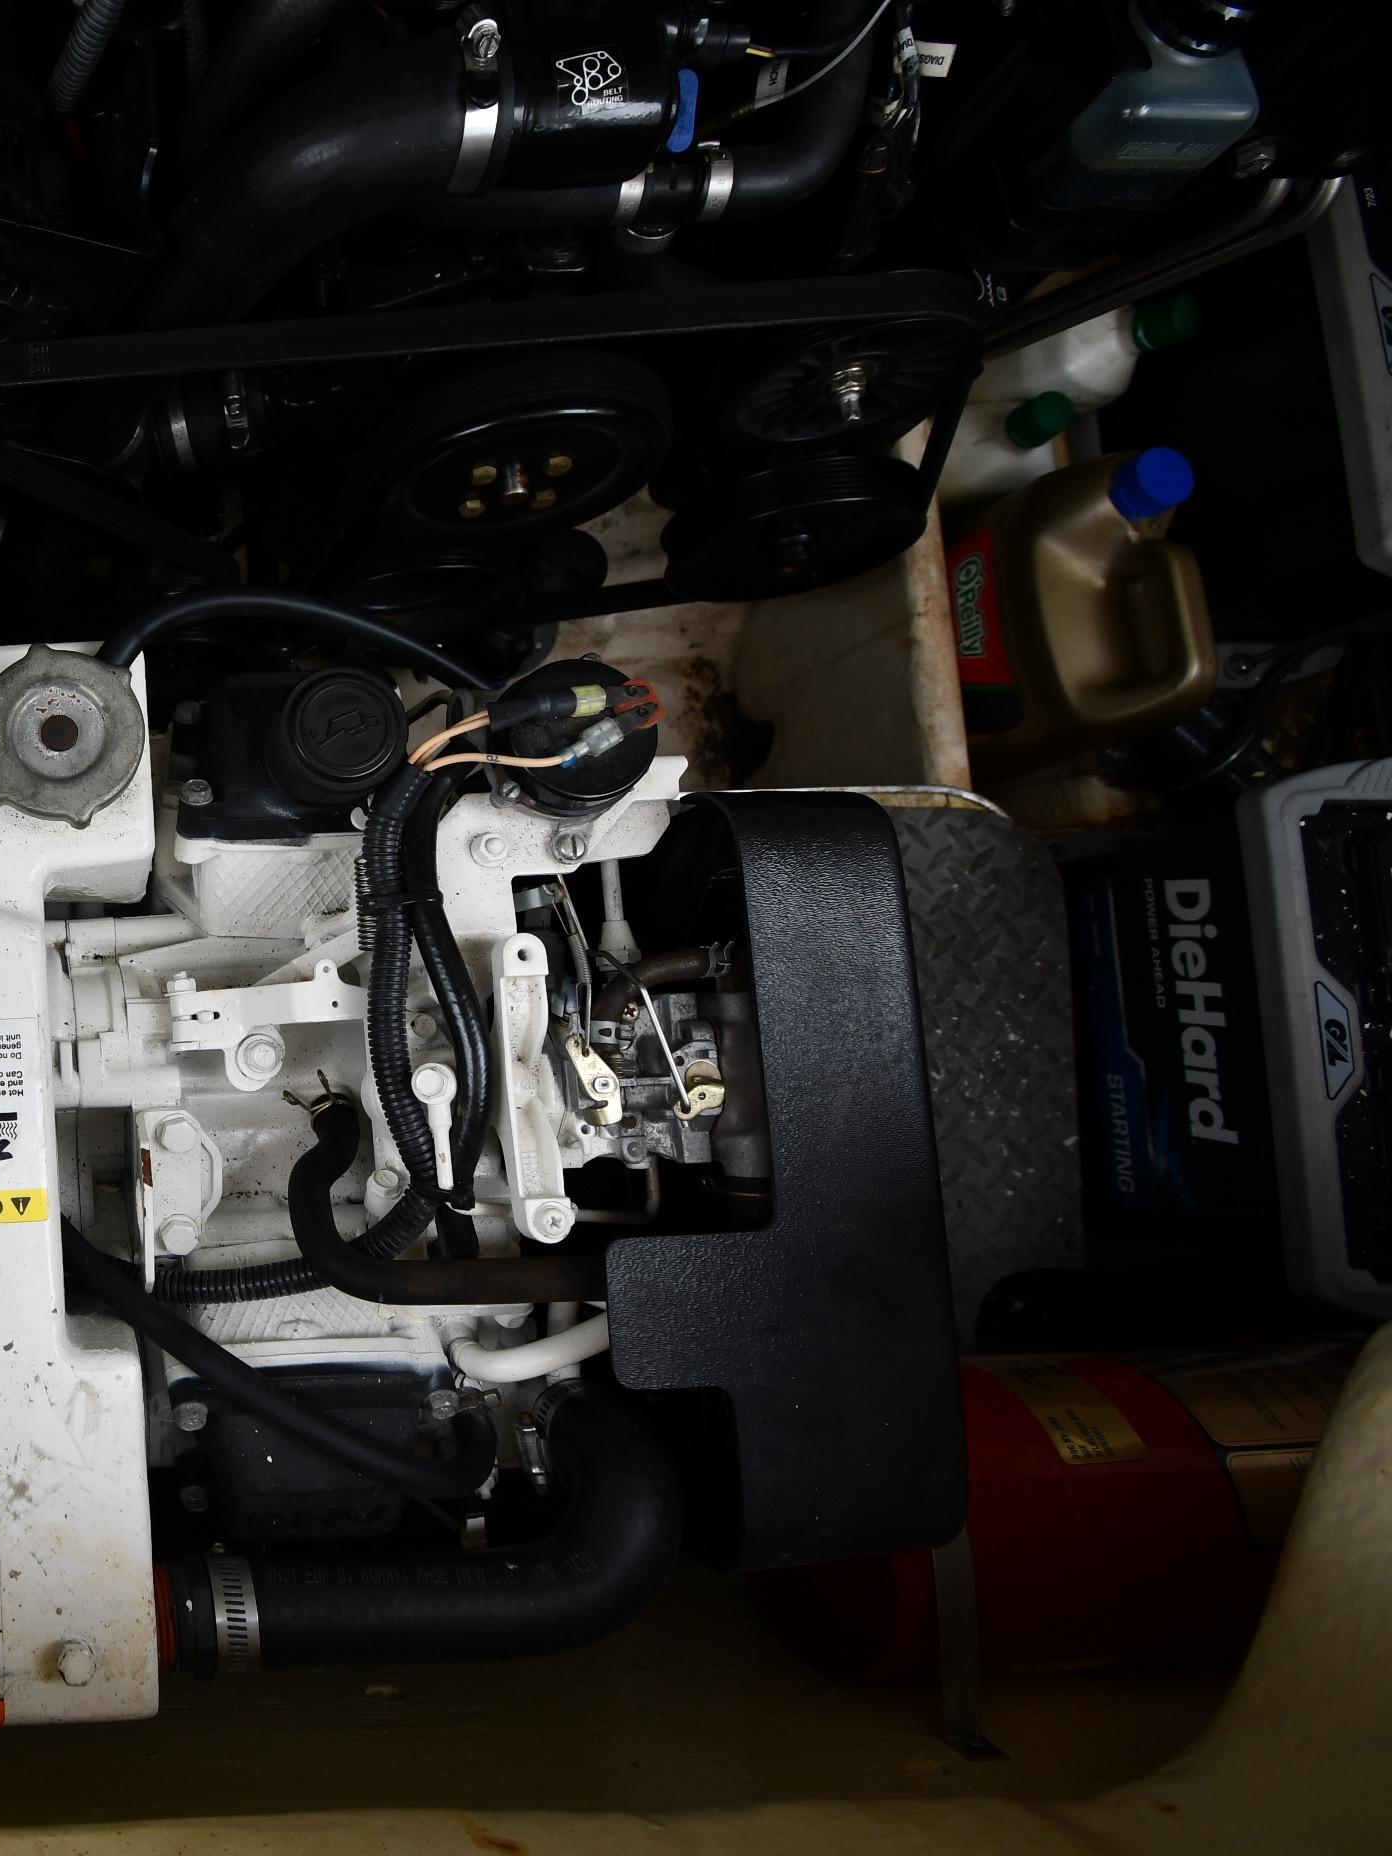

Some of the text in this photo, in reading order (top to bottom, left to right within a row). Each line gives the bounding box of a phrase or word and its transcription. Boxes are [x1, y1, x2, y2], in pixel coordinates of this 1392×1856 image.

[588, 95, 623, 107] ROUTING
[603, 87, 623, 96] BELT
[918, 55, 944, 65] DIAGS
[957, 555, 985, 656] O'Reilly
[1144, 878, 1166, 1008] POWER AHEAD
[1164, 879, 1238, 1144] DieHard
[1107, 1075, 1133, 1192] STARTING
